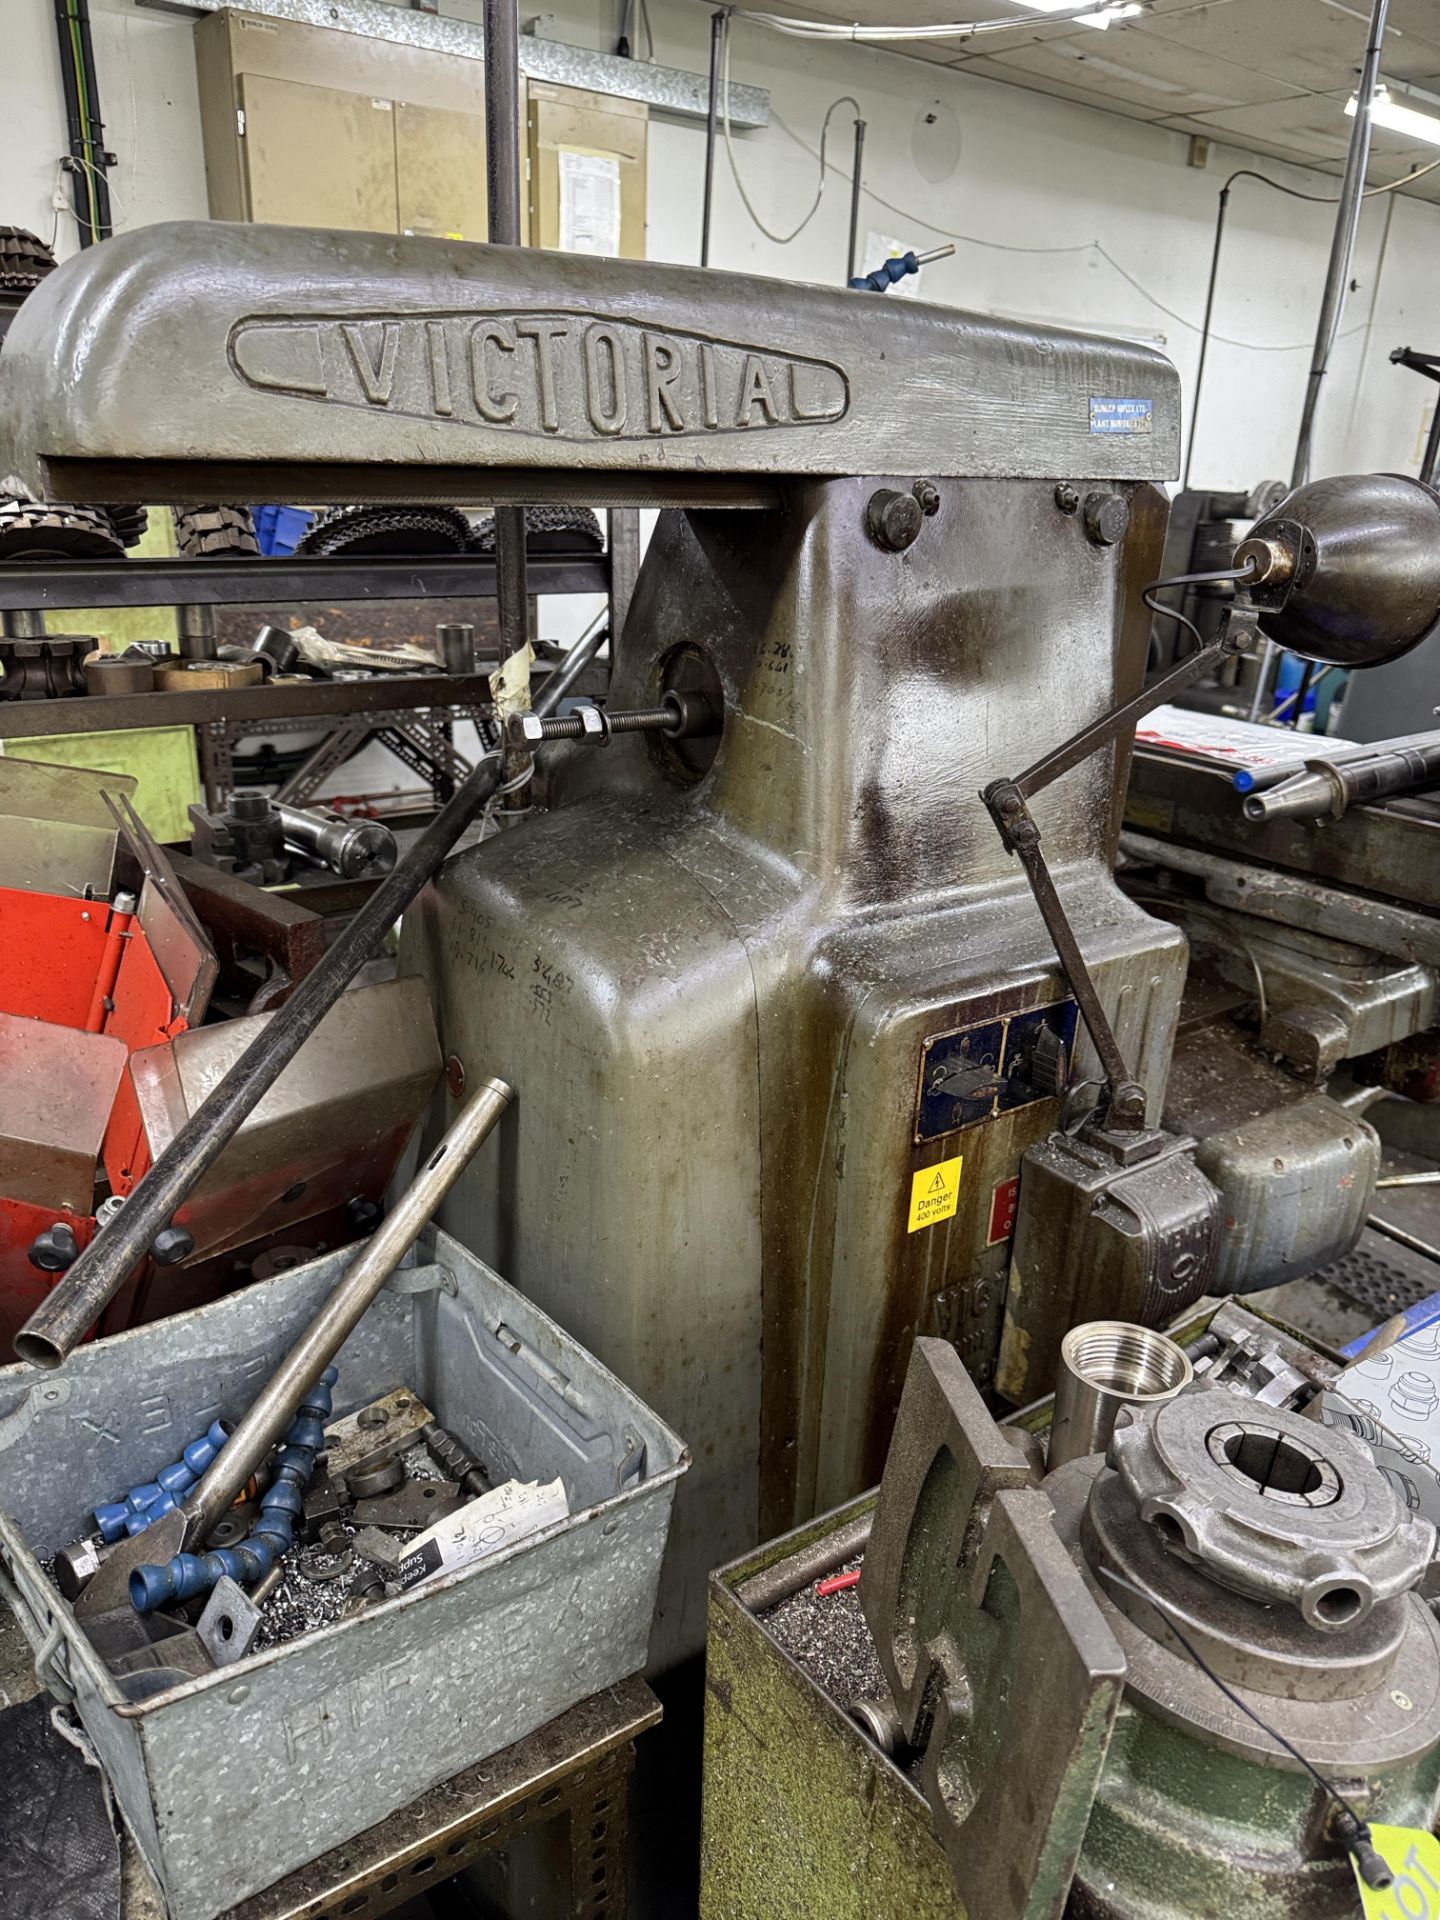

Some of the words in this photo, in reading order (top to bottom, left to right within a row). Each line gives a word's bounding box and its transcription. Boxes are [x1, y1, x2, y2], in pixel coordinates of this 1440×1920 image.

[341, 318, 778, 435] VICTORIA
[917, 1192, 953, 1211] Danger
[916, 1209, 931, 1222] 400
[932, 1203, 951, 1216] volts
